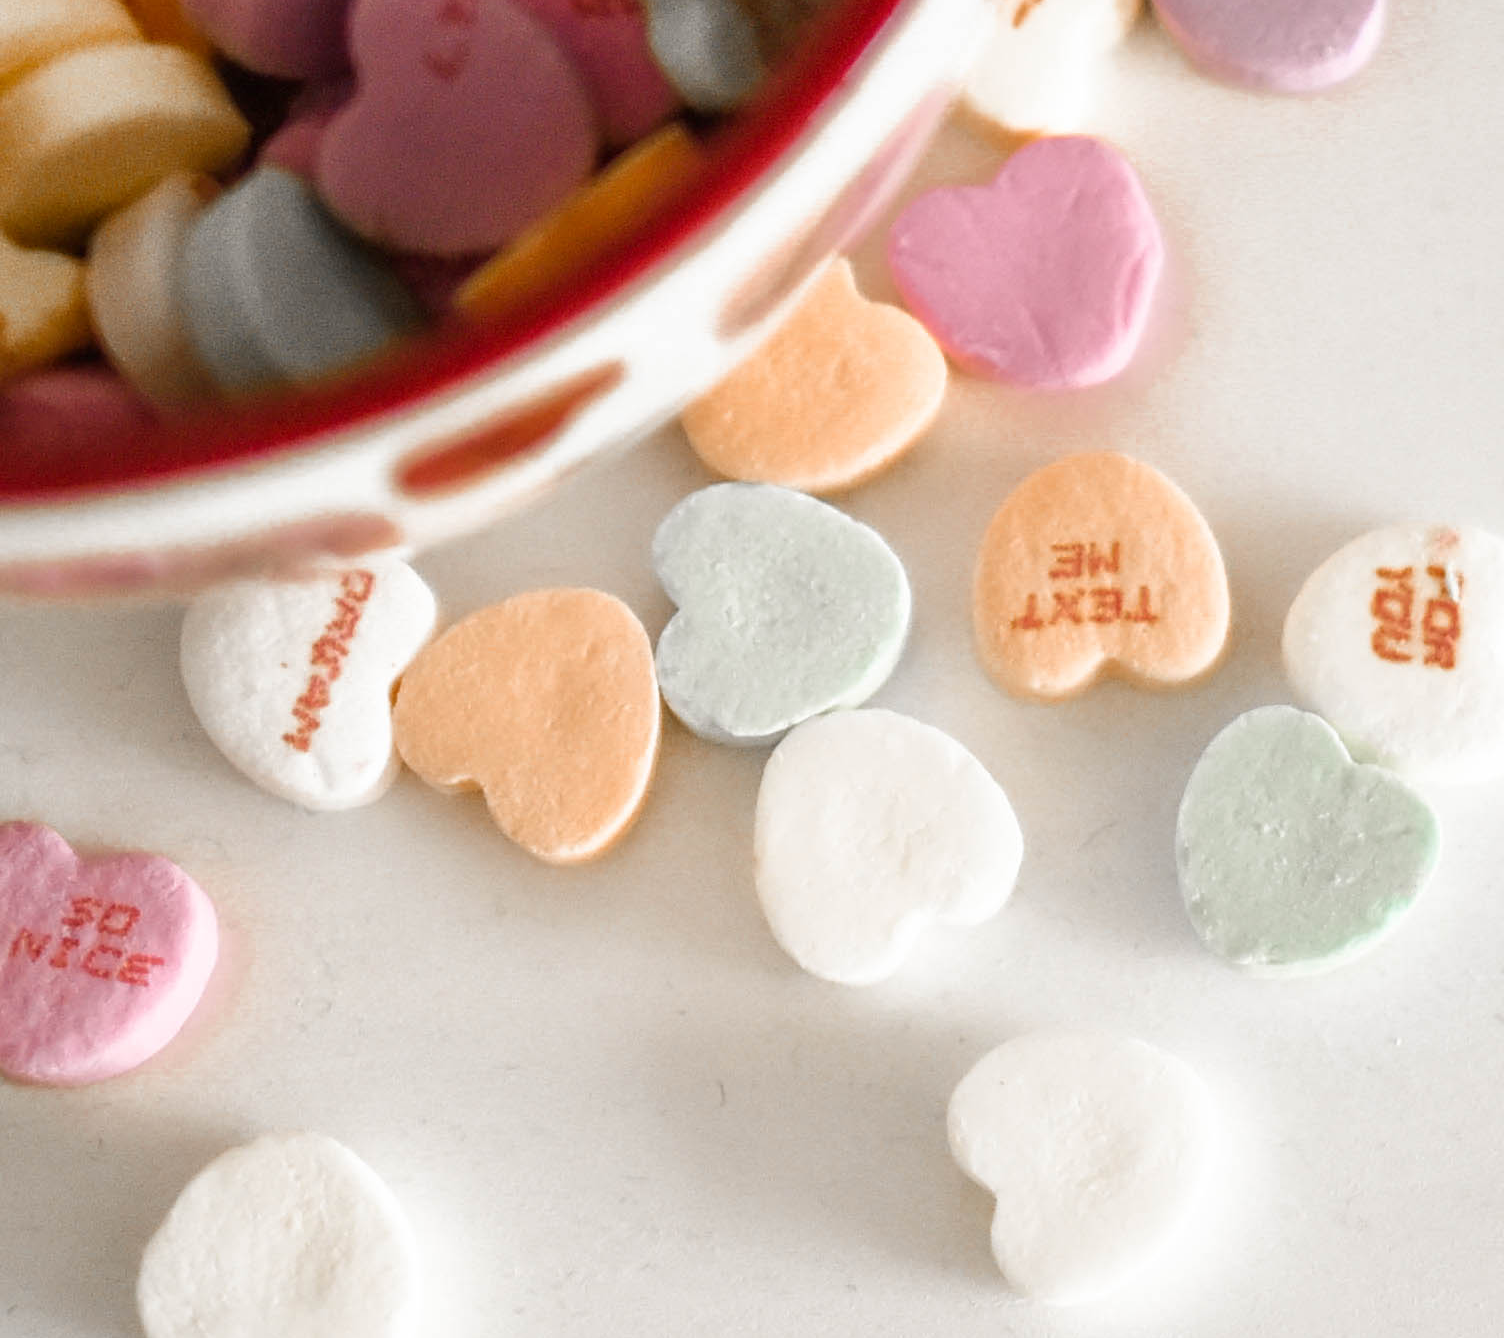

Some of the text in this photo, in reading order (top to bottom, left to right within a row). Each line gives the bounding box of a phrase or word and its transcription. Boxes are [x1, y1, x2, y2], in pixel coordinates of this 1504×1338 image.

[1048, 540, 1122, 580] ME
[1011, 585, 1159, 630] TEXT
[1371, 566, 1414, 663] YOU
[1422, 564, 1464, 670] FOR
[61, 896, 141, 937] SO
[8, 927, 165, 987] NICE
